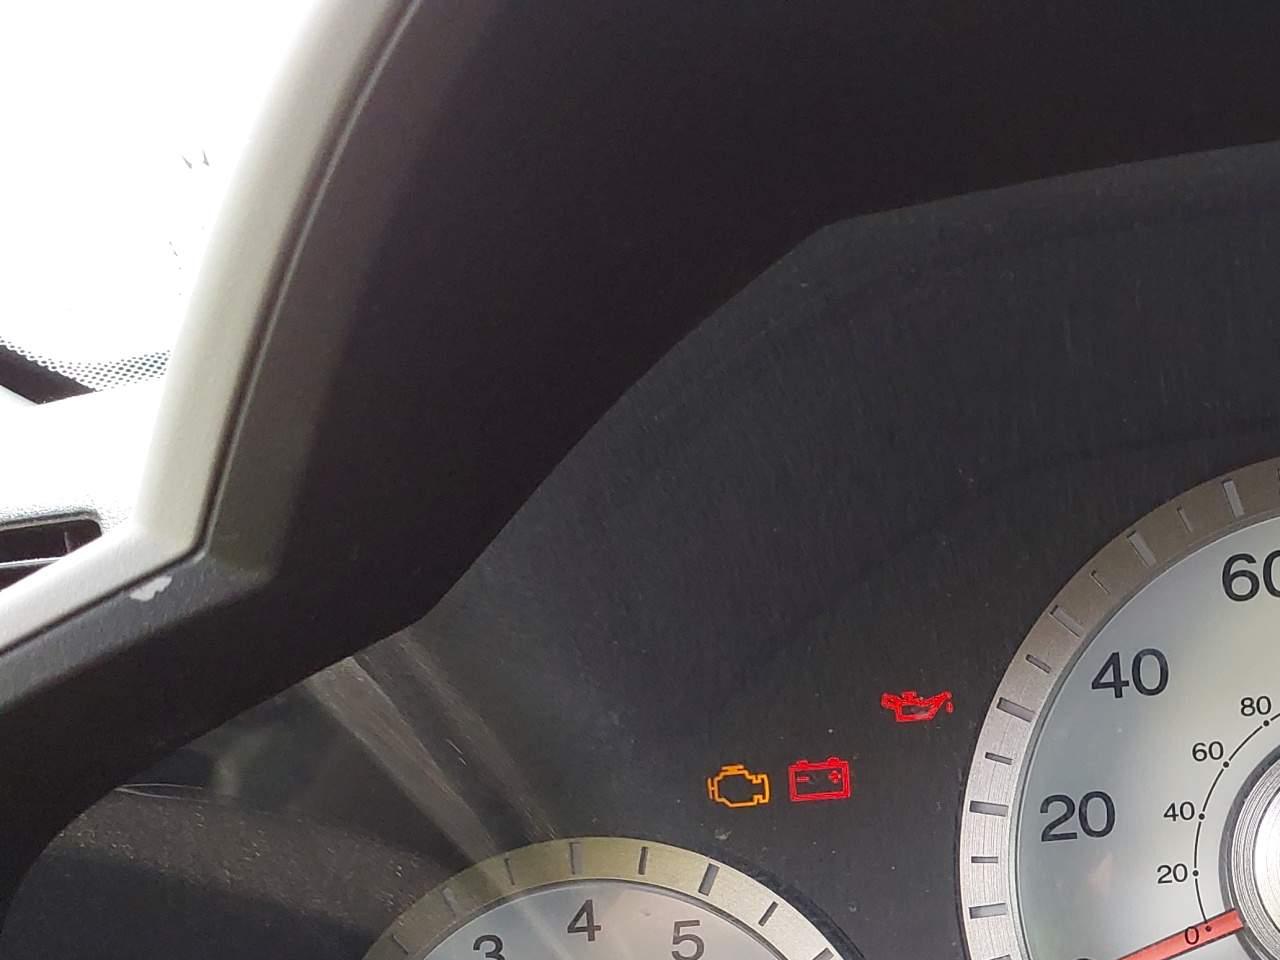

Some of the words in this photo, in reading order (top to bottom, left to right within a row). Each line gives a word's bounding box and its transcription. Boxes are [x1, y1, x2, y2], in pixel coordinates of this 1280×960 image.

[1091, 648, 1169, 698] 40
[1241, 696, 1271, 716] 80
[1192, 741, 1224, 761] 60
[1039, 791, 1116, 842] 20
[1163, 802, 1195, 821] 40
[1157, 864, 1188, 883] 20
[567, 900, 601, 941] 4
[1184, 926, 1200, 945] 0
